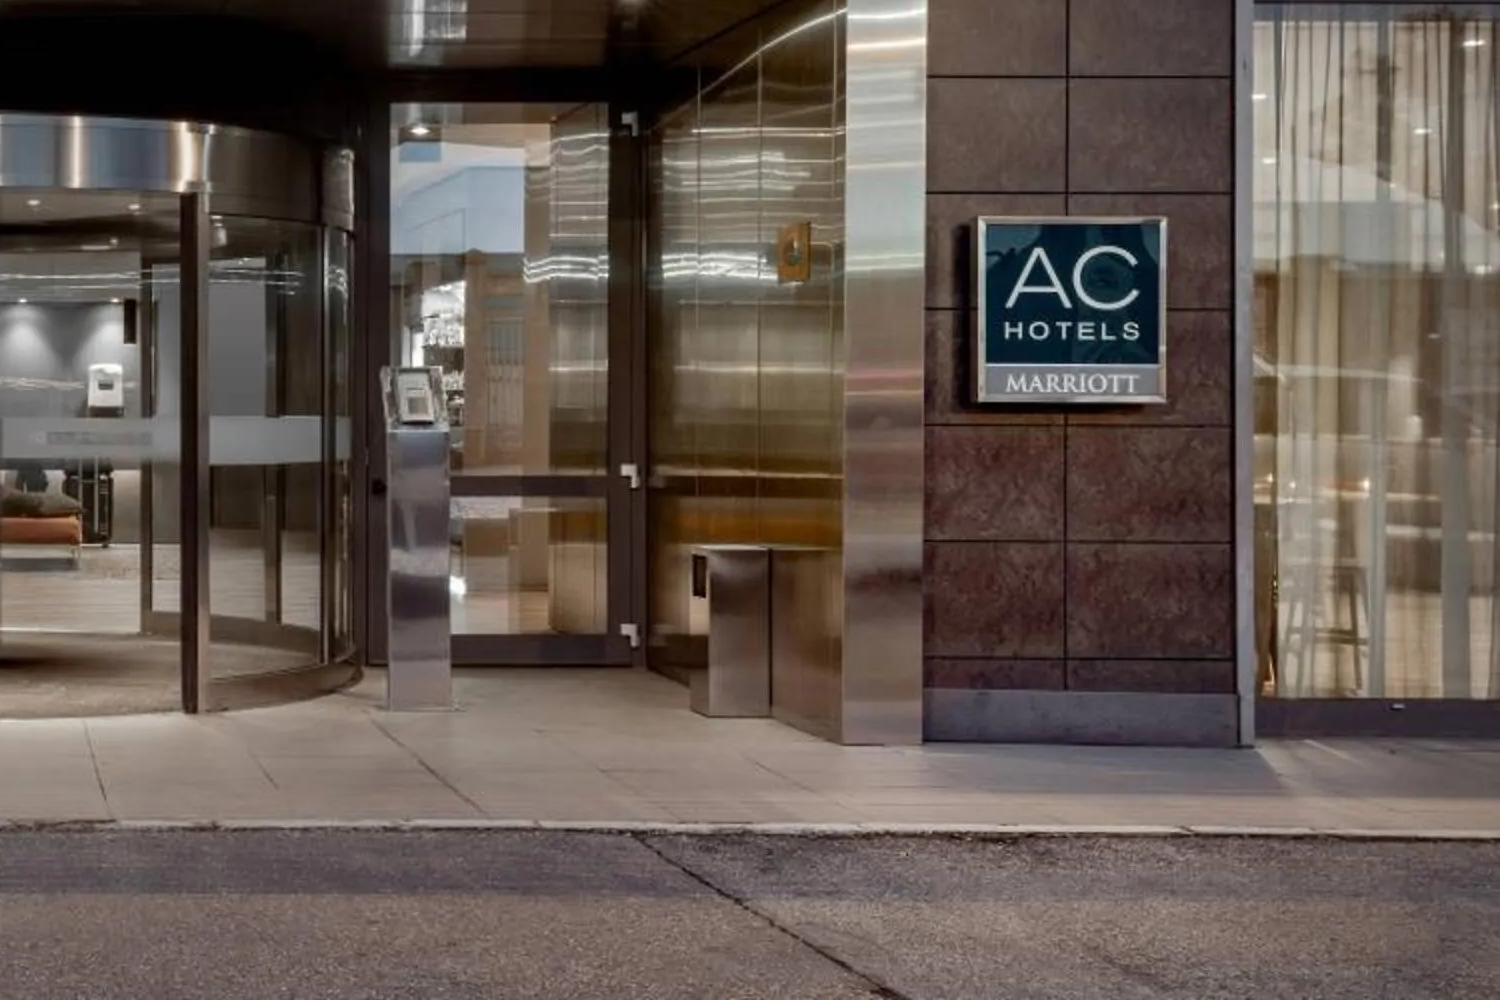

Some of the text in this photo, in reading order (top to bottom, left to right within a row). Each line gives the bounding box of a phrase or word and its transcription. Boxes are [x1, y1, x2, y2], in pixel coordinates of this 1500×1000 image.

[1005, 245, 1141, 311] AC
[1004, 321, 1141, 341] HOTELS
[1005, 373, 1142, 394] MARRIOTT
